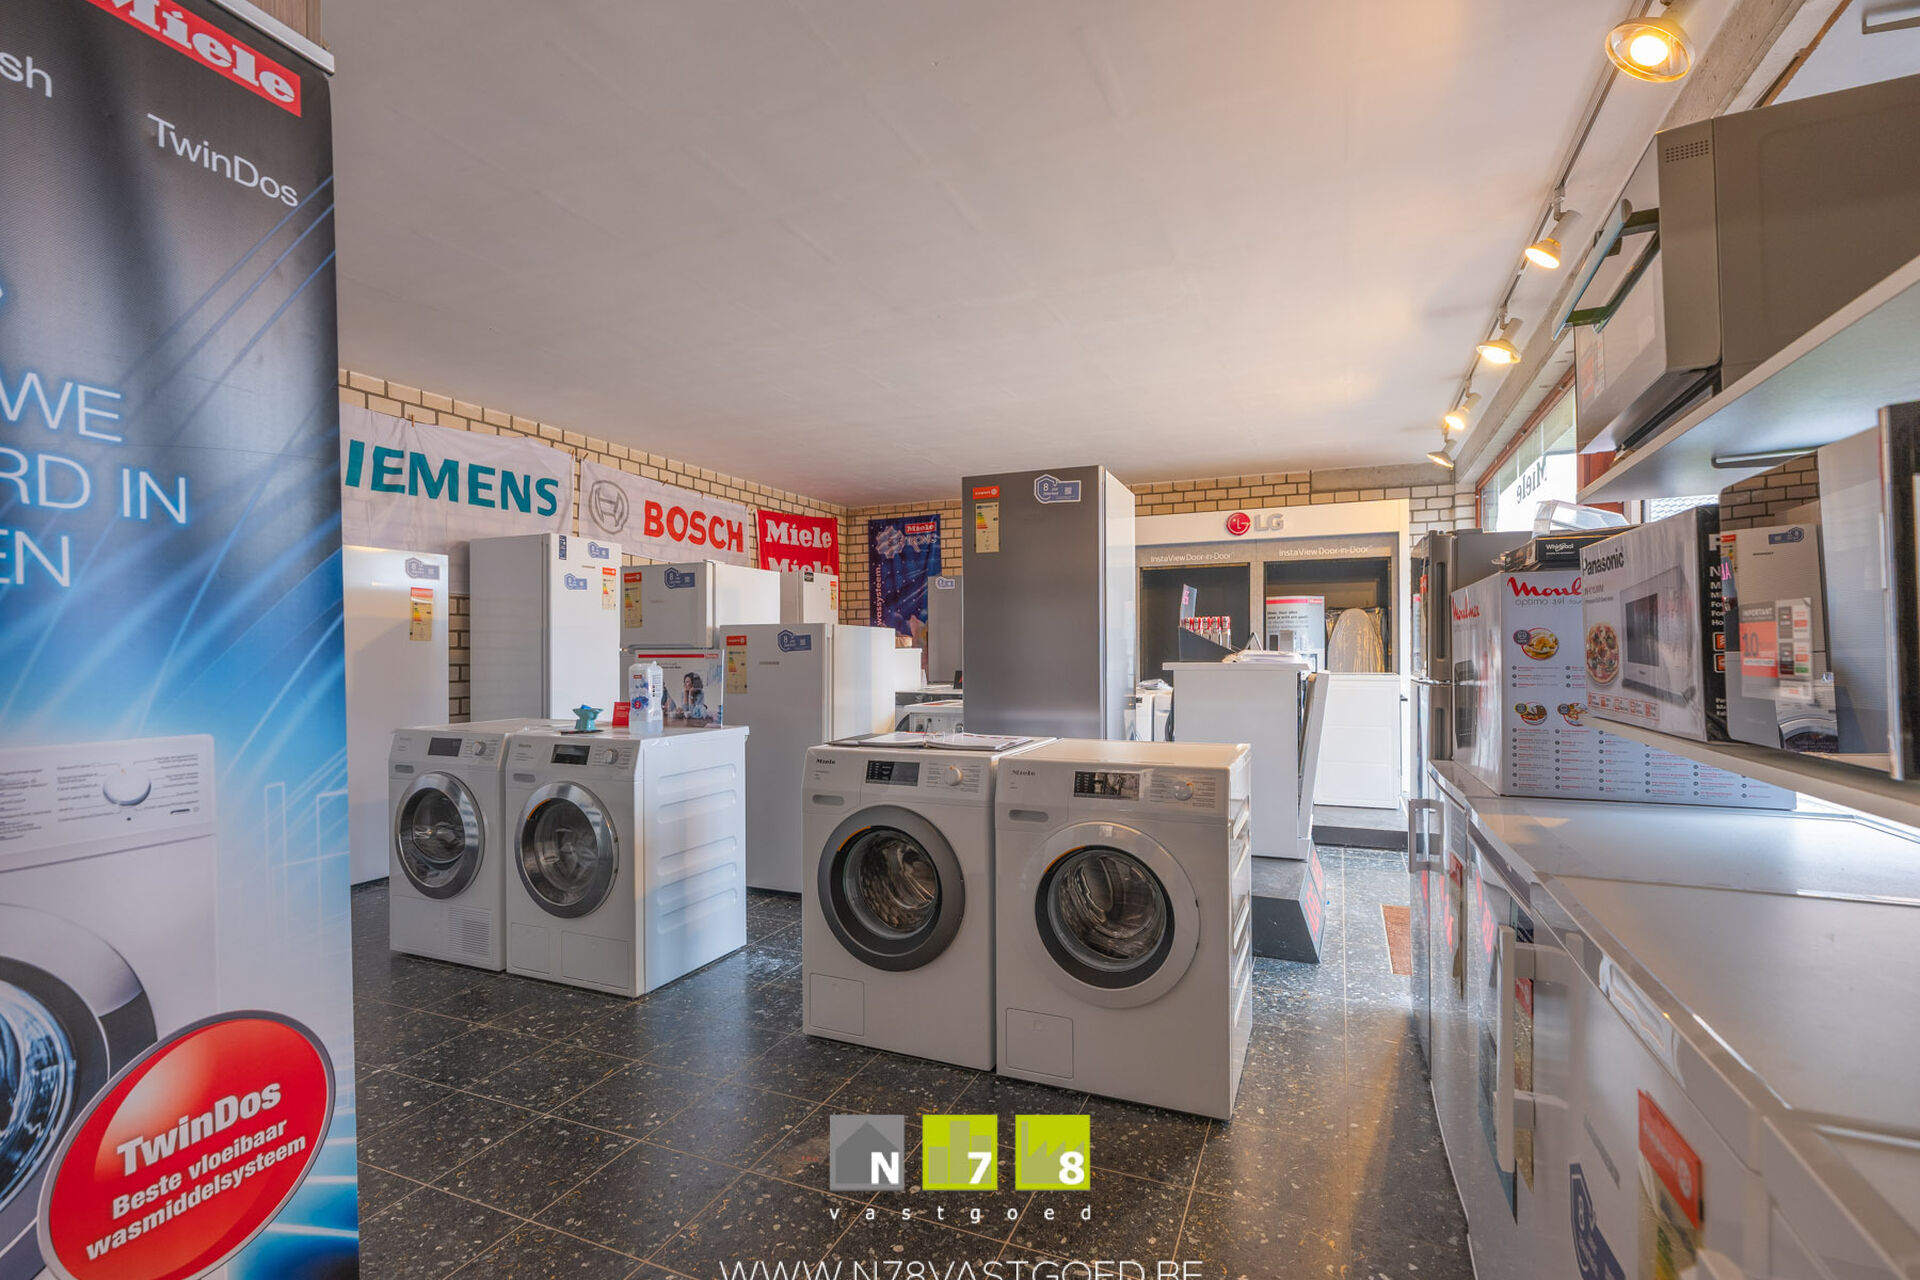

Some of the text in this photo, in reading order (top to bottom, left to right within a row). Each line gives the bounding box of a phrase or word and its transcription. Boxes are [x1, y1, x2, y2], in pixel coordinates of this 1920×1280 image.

[147, 113, 299, 208] TwinDos
[122, 468, 187, 524] IN
[345, 439, 559, 517] IEMENS
[643, 500, 743, 552] BOSCH
[765, 518, 832, 548] Miele
[906, 524, 935, 533] Miele
[1253, 513, 1284, 531] LG
[0, 528, 71, 588] N
[1582, 547, 1625, 576] Panasonic
[116, 1083, 282, 1177] TwinDos
[86, 1136, 306, 1261] wasmiddelsysteem
[112, 1120, 287, 1220] Beste vloeibaar
